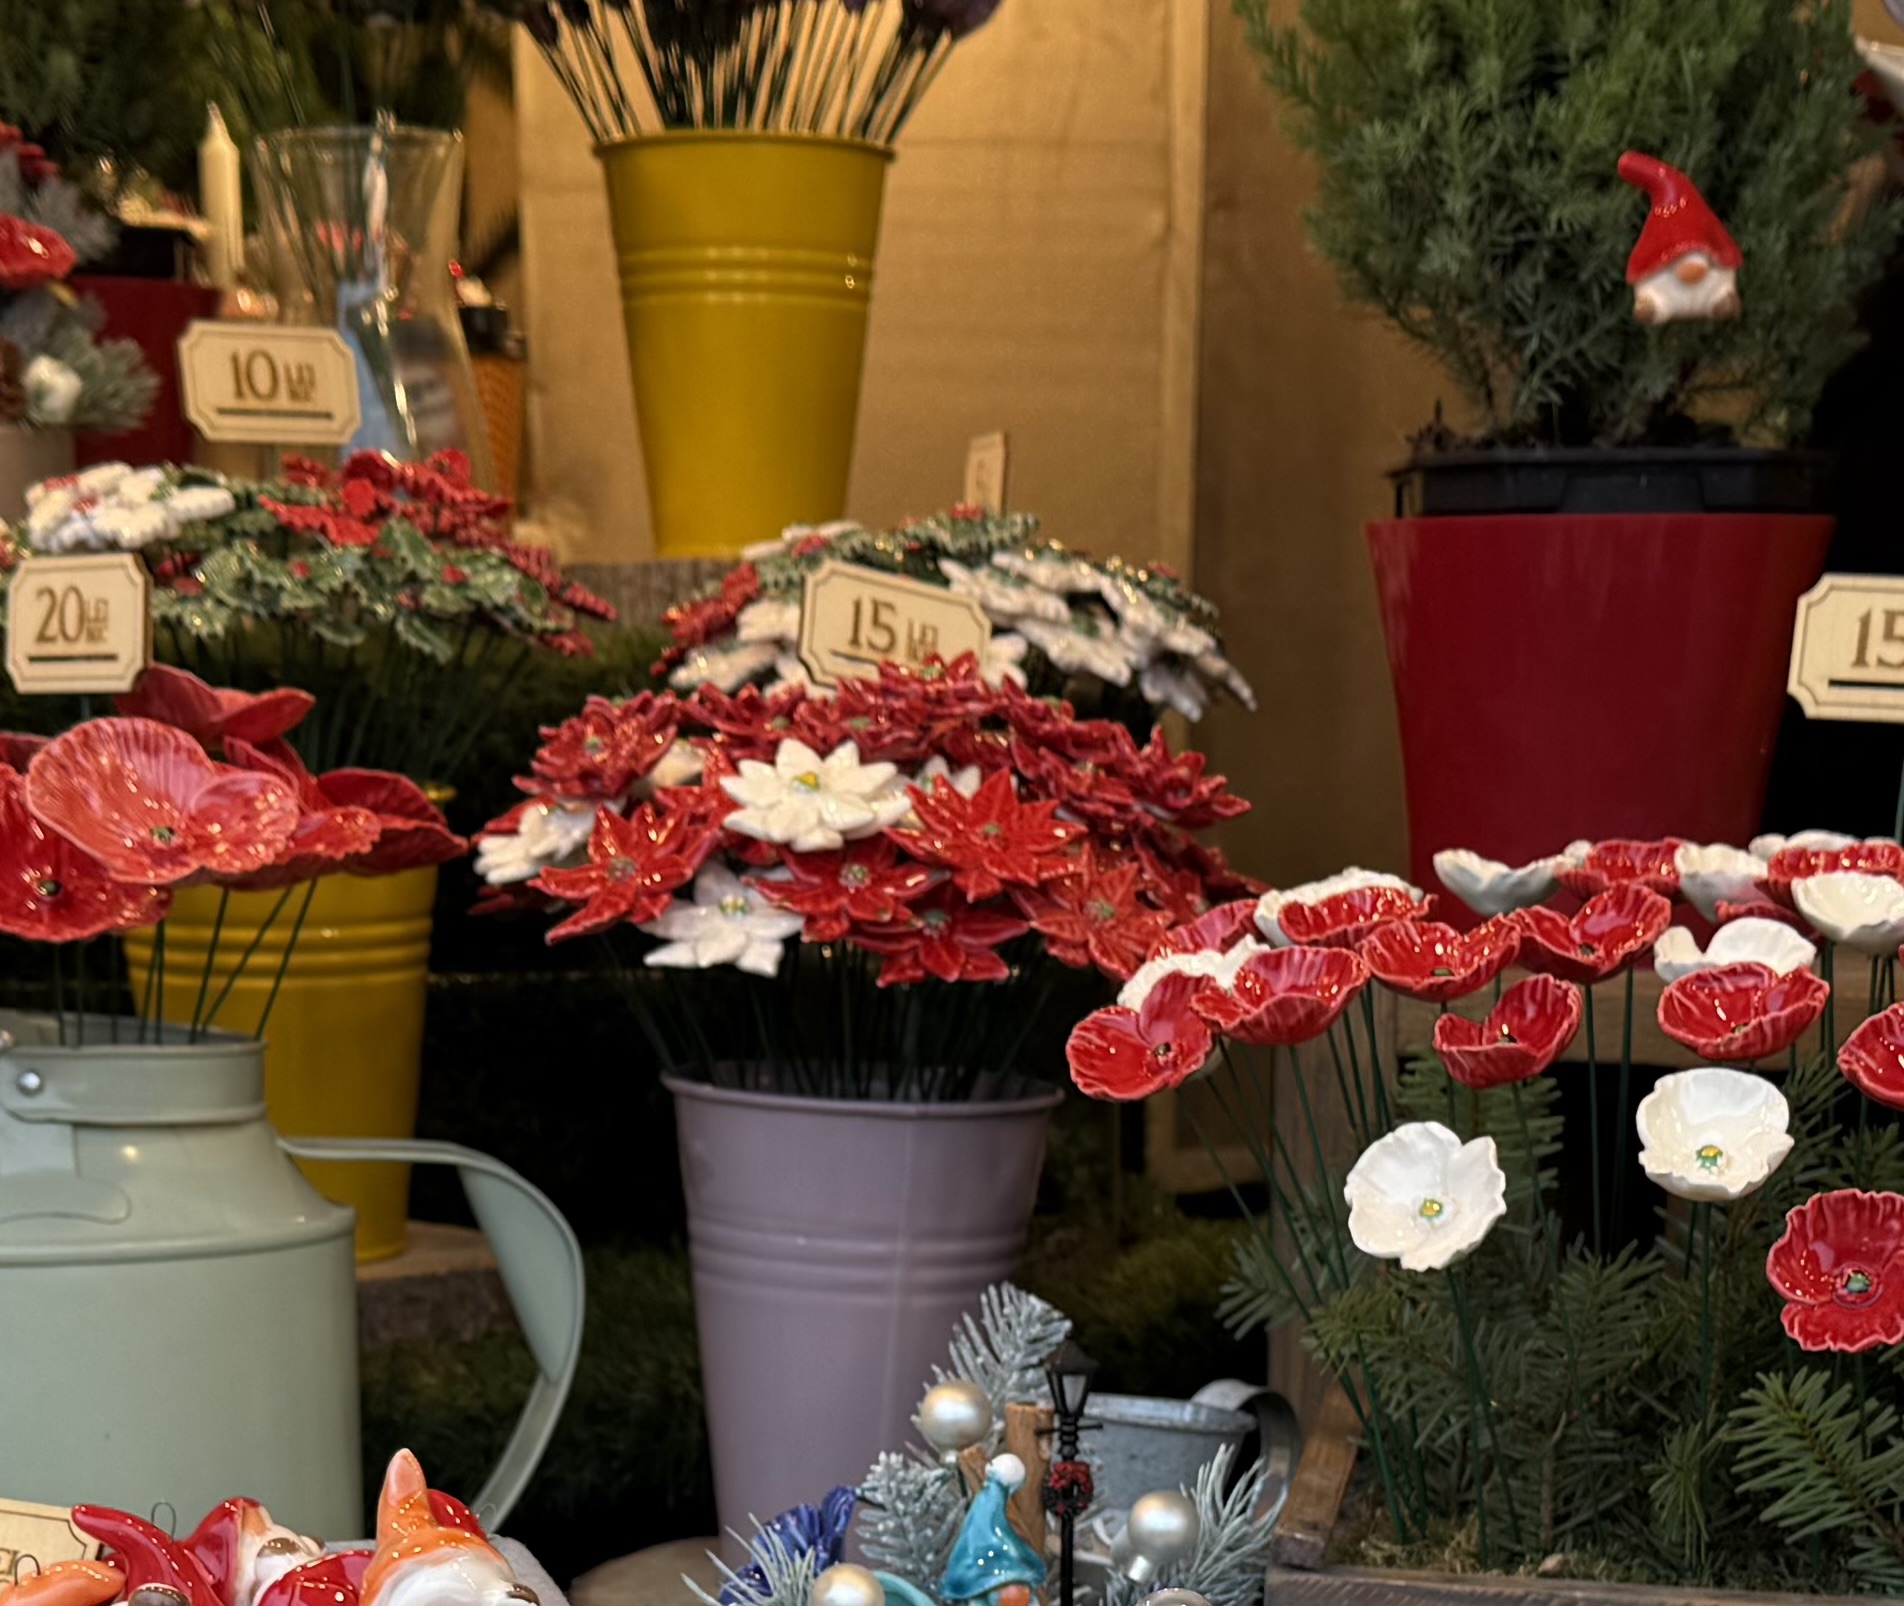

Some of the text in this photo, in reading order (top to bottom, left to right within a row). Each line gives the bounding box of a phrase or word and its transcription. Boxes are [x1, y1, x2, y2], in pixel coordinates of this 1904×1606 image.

[230, 349, 279, 401] 10
[35, 585, 85, 643] 20
[848, 597, 897, 654] 15
